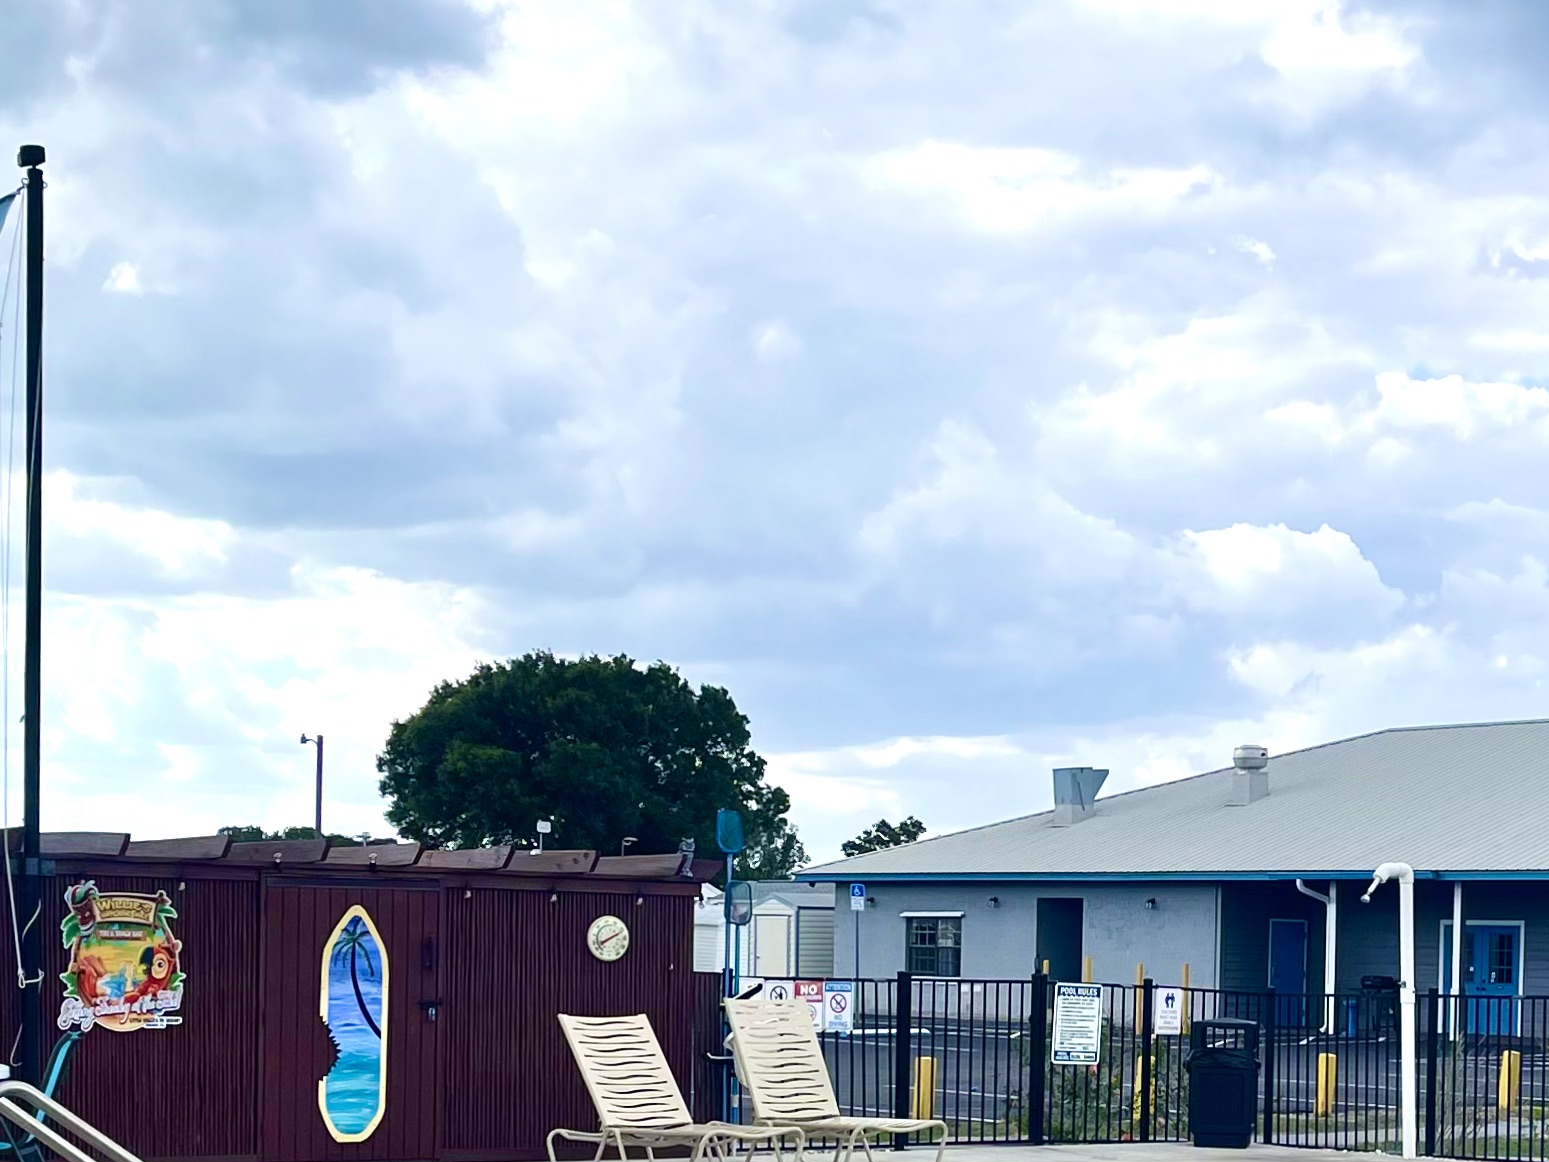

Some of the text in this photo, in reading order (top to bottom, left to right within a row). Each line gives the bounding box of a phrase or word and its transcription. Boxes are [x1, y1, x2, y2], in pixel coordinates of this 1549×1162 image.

[799, 984, 818, 995] NO
[1060, 986, 1098, 996] POOL RULES
